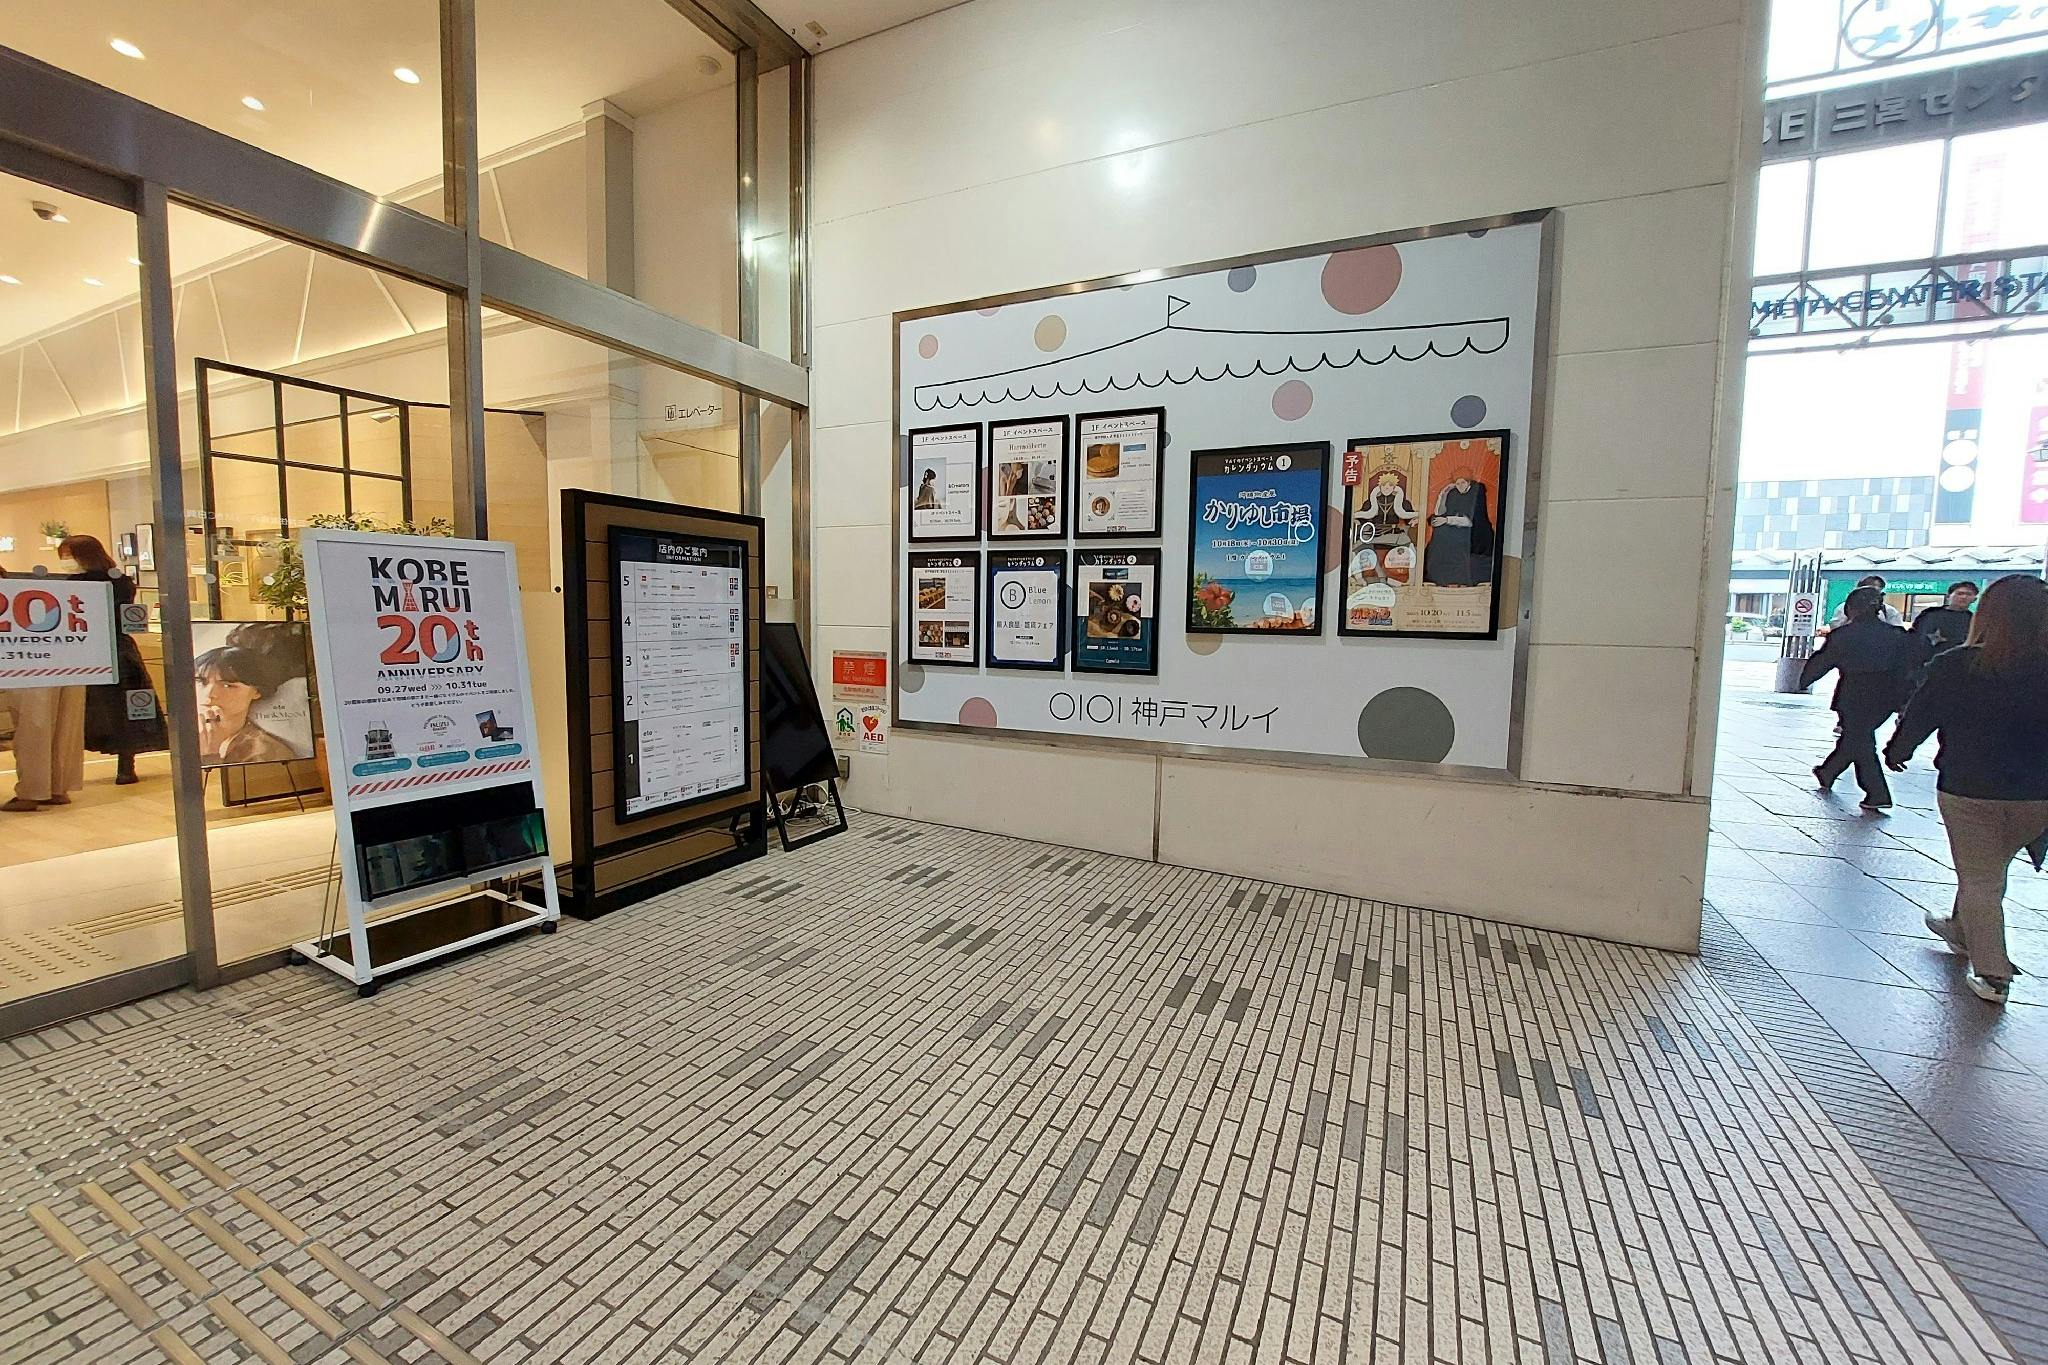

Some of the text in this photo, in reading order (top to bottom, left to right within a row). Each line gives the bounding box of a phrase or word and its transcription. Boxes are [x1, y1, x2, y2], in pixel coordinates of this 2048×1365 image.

[678, 404, 722, 419] エレベーター
[1224, 462, 1274, 474] カレンダリウム
[1344, 454, 1359, 482] 予告
[1203, 499, 1312, 531] かりゆし市場
[658, 544, 708, 558] 店内のご案内
[368, 556, 470, 587] KOBE
[623, 575, 630, 586] 5
[1028, 586, 1047, 594] Blue
[372, 585, 472, 613] MARUI
[624, 615, 632, 627] 4
[625, 655, 632, 667] 3
[377, 666, 484, 680] ANNIVERSARY
[377, 680, 487, 694] 09.27wed 10.31tue
[626, 695, 633, 706] 2
[1131, 697, 1279, 734] 神戸マルイ
[863, 732, 884, 742] AED
[627, 753, 634, 765] 1
